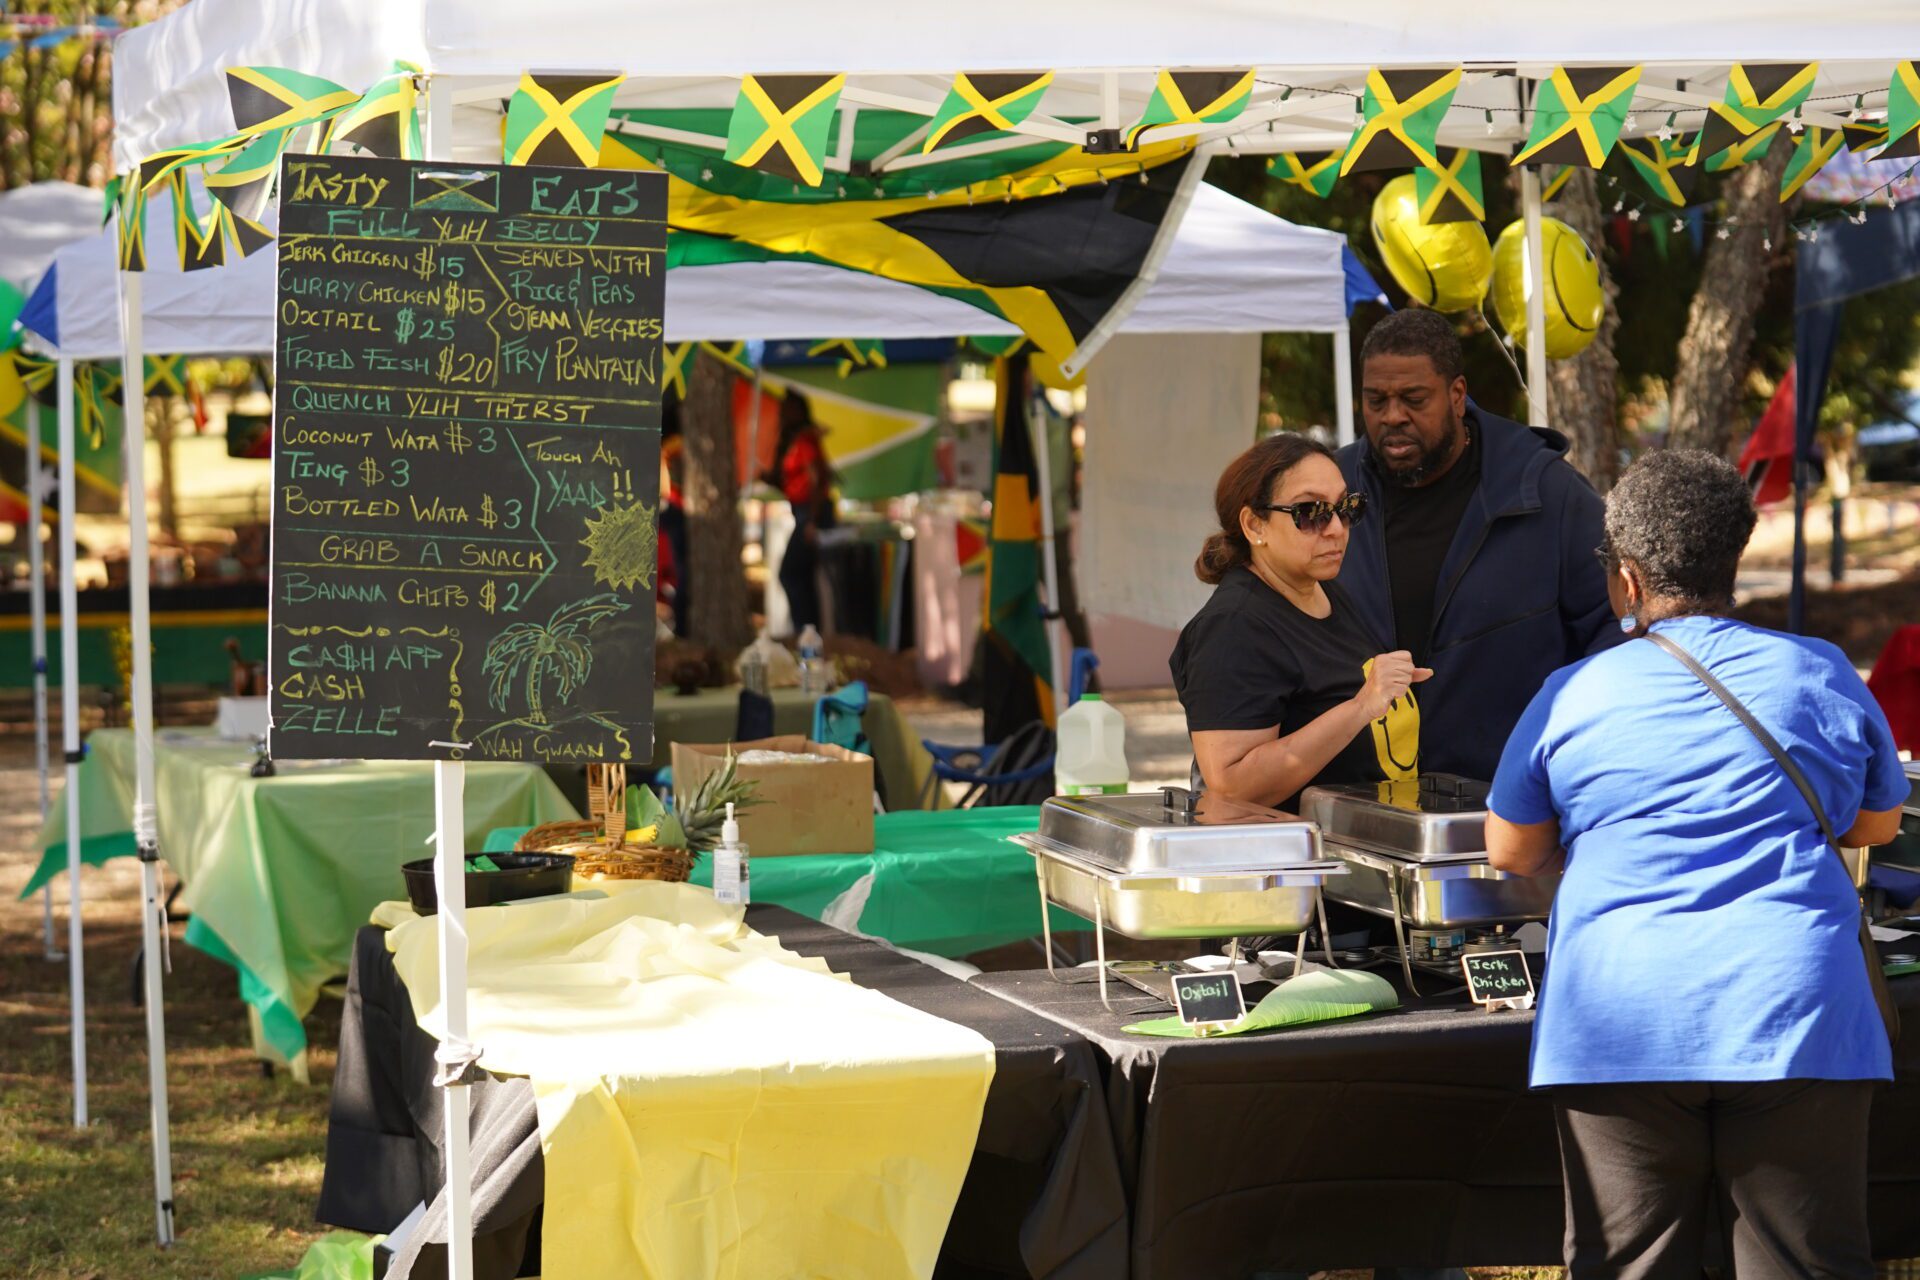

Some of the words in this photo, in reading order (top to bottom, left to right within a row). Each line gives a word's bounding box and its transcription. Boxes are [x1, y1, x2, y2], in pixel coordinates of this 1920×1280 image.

[287, 162, 390, 209] TASTY
[531, 174, 639, 215] EATS
[328, 209, 421, 239] FULL
[432, 216, 488, 246] YUH
[496, 219, 600, 246] BELLY
[280, 237, 327, 262] JERK
[331, 243, 408, 270] CHICKEN
[494, 244, 584, 267] SERVED
[589, 248, 650, 277] WITH
[279, 267, 356, 303] CURRY
[359, 281, 440, 306] CHICKEN
[591, 275, 635, 305] PEAS
[507, 302, 571, 332] STEAM
[576, 308, 663, 342] VEGGIES
[282, 334, 355, 371] FRIED
[362, 348, 430, 375] FISH
[501, 336, 549, 383] FRY
[555, 336, 656, 386] PLANTAIN
[293, 385, 391, 412] QUENCH
[407, 392, 460, 419] YUH
[475, 397, 595, 424] THIRST
[282, 416, 374, 447] COCONUT
[386, 425, 440, 451] WATA
[281, 450, 349, 487] TING
[281, 485, 400, 518] BOTTLED
[410, 494, 469, 524] WATA
[319, 535, 400, 562] GRAB
[419, 541, 443, 566] A
[459, 544, 544, 570] SNACK
[280, 572, 388, 606] BANANA
[398, 578, 469, 607] CHIPS
[384, 644, 444, 671] APP
[280, 672, 366, 700] CASH
[280, 703, 402, 737] ZELLE
[475, 728, 523, 760] WAH
[1469, 959, 1509, 971] Jerk
[1180, 979, 1229, 1001] Oxtail
[1472, 975, 1526, 992] Chicken
